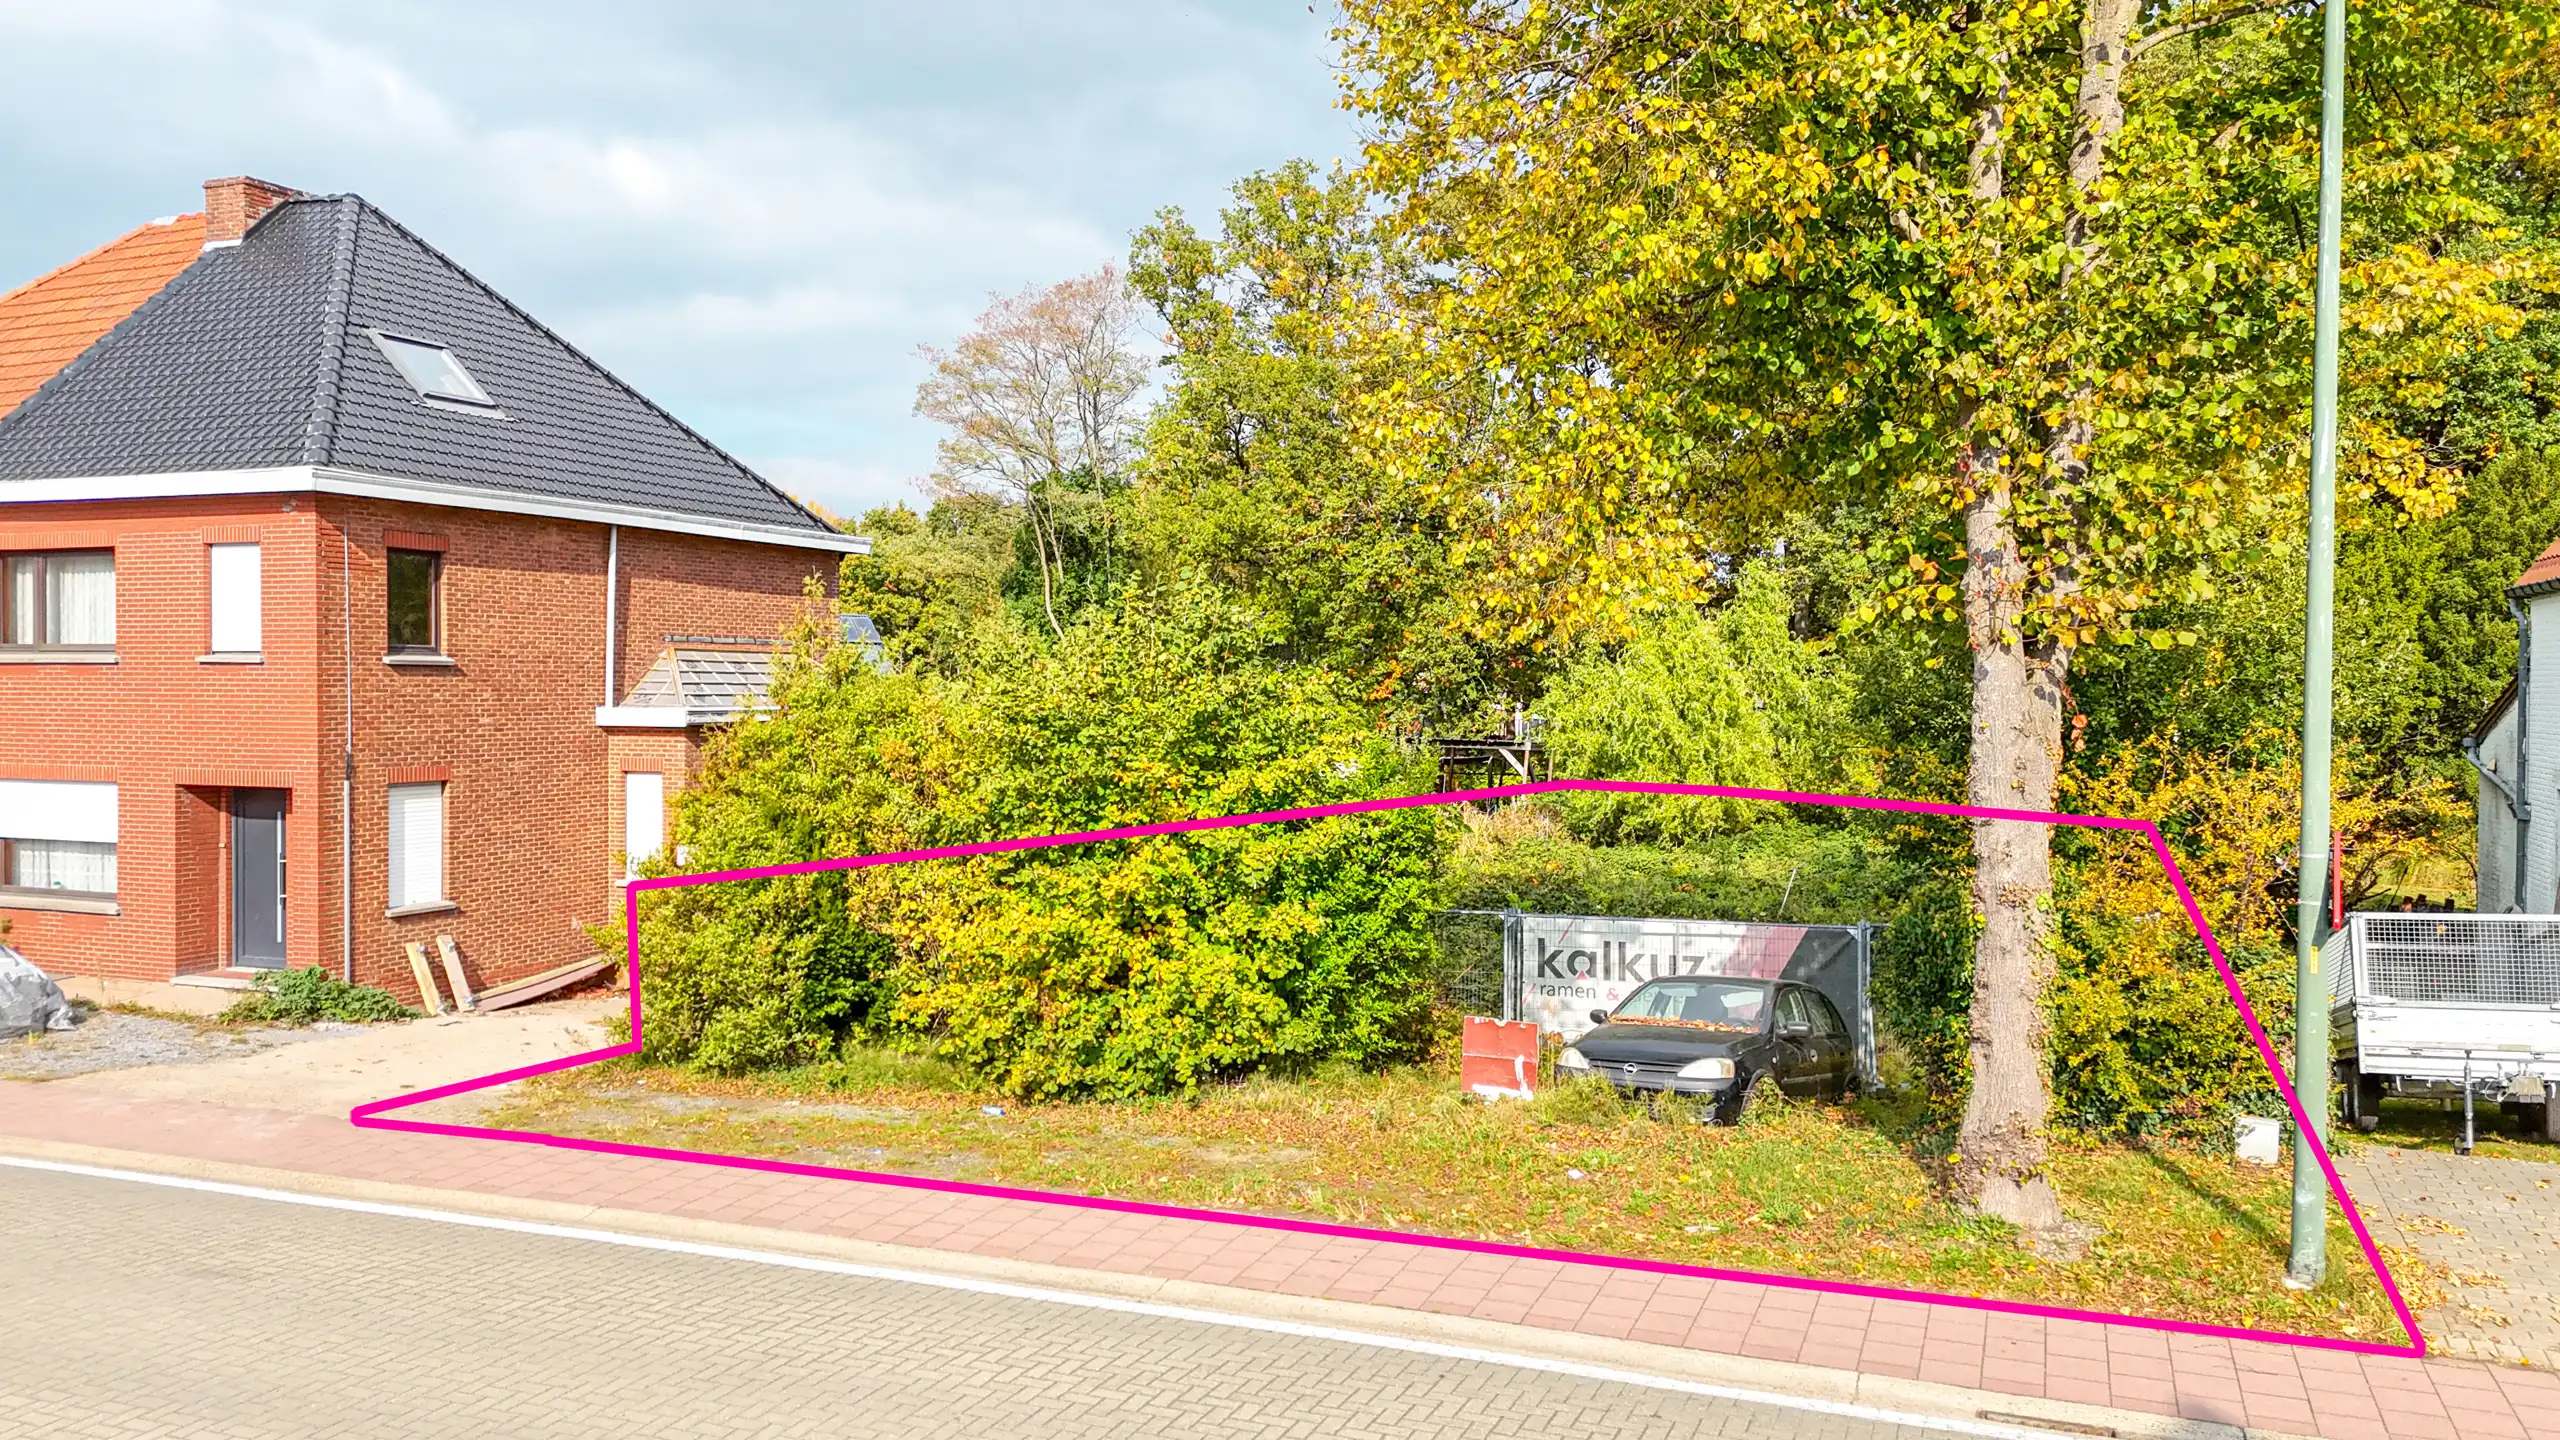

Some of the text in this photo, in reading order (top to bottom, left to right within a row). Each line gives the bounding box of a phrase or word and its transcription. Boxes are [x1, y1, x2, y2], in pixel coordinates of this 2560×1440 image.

[1538, 938, 1704, 982] kalkuz
[1540, 984, 1596, 999] ramen
[1606, 988, 1619, 1001] &
